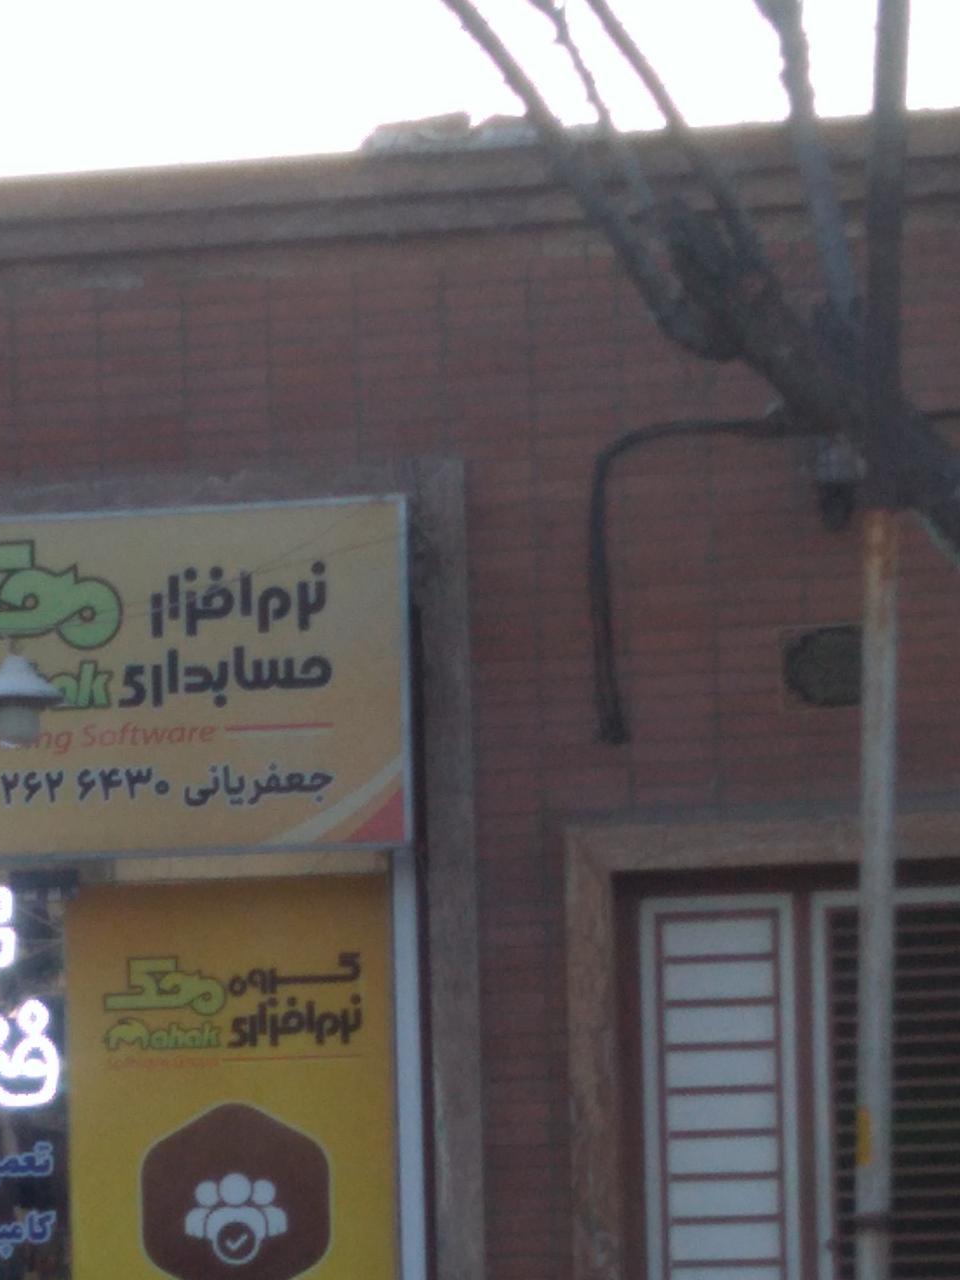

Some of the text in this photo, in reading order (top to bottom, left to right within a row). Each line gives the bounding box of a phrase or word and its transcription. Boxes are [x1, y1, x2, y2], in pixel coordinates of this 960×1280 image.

[150, 561, 329, 638] نرم افزار
[118, 646, 334, 708] حسابداری
[81, 722, 216, 749] Software
[1, 770, 65, 804] ۲۶۲
[77, 766, 170, 801] ۶۴۳۰
[183, 762, 334, 807] جعفریانی
[315, 993, 362, 1046] نرم
